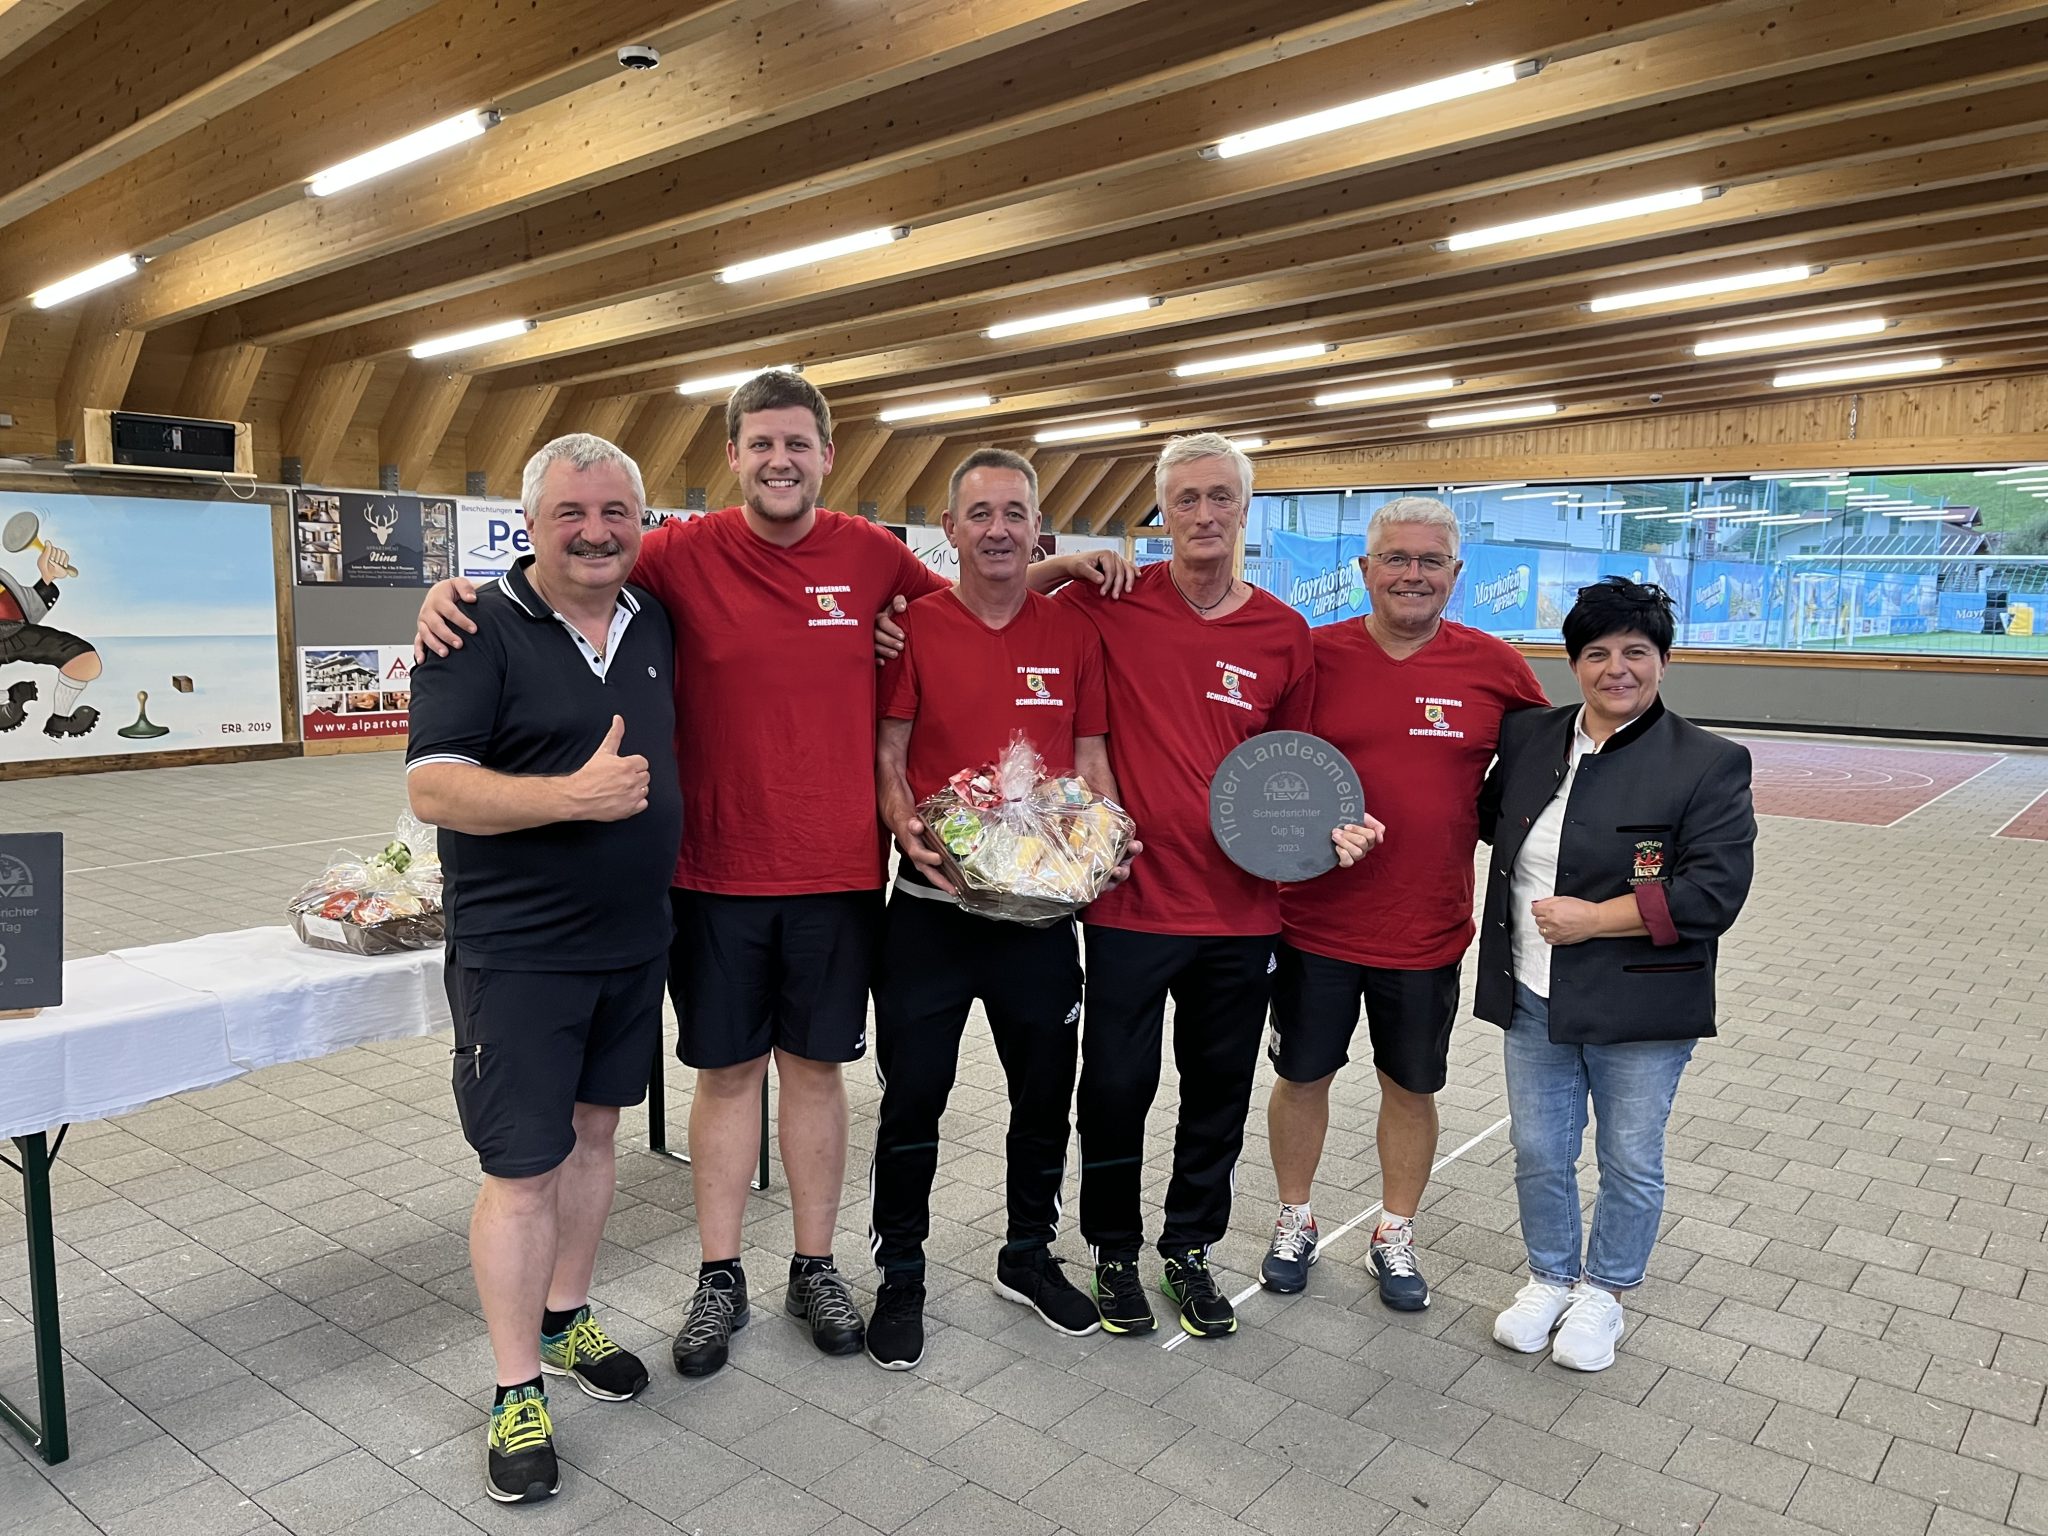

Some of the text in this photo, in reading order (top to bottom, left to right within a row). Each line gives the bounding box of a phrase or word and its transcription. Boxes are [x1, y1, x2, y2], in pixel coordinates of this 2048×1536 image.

[461, 505, 513, 514] Beschichtungen
[369, 551, 398, 562] Nina
[805, 585, 851, 594] EV ANGERBERG
[1473, 568, 1520, 608] Mayrhofen
[808, 618, 859, 627] SCHIEDSRICHTER
[1017, 666, 1060, 675] EV ANGERBERG
[1216, 660, 1257, 680] EV ANGERBERG
[1015, 698, 1064, 706] SCHIEDSRICHTER
[1206, 691, 1253, 711] SCHIEDSRICHTER
[1415, 696, 1463, 708] EV ANGERBERG
[247, 722, 272, 733] 2019
[1408, 728, 1465, 739] SCHIEDSRICHTER
[1216, 770, 1242, 849] Tiroler
[1252, 808, 1321, 819] Schiedsrichter
[1271, 825, 1305, 837] Cup Tag
[1277, 844, 1300, 853] 2023
[1634, 841, 1663, 849] TIROLER
[0, 922, 22, 934] Tag
